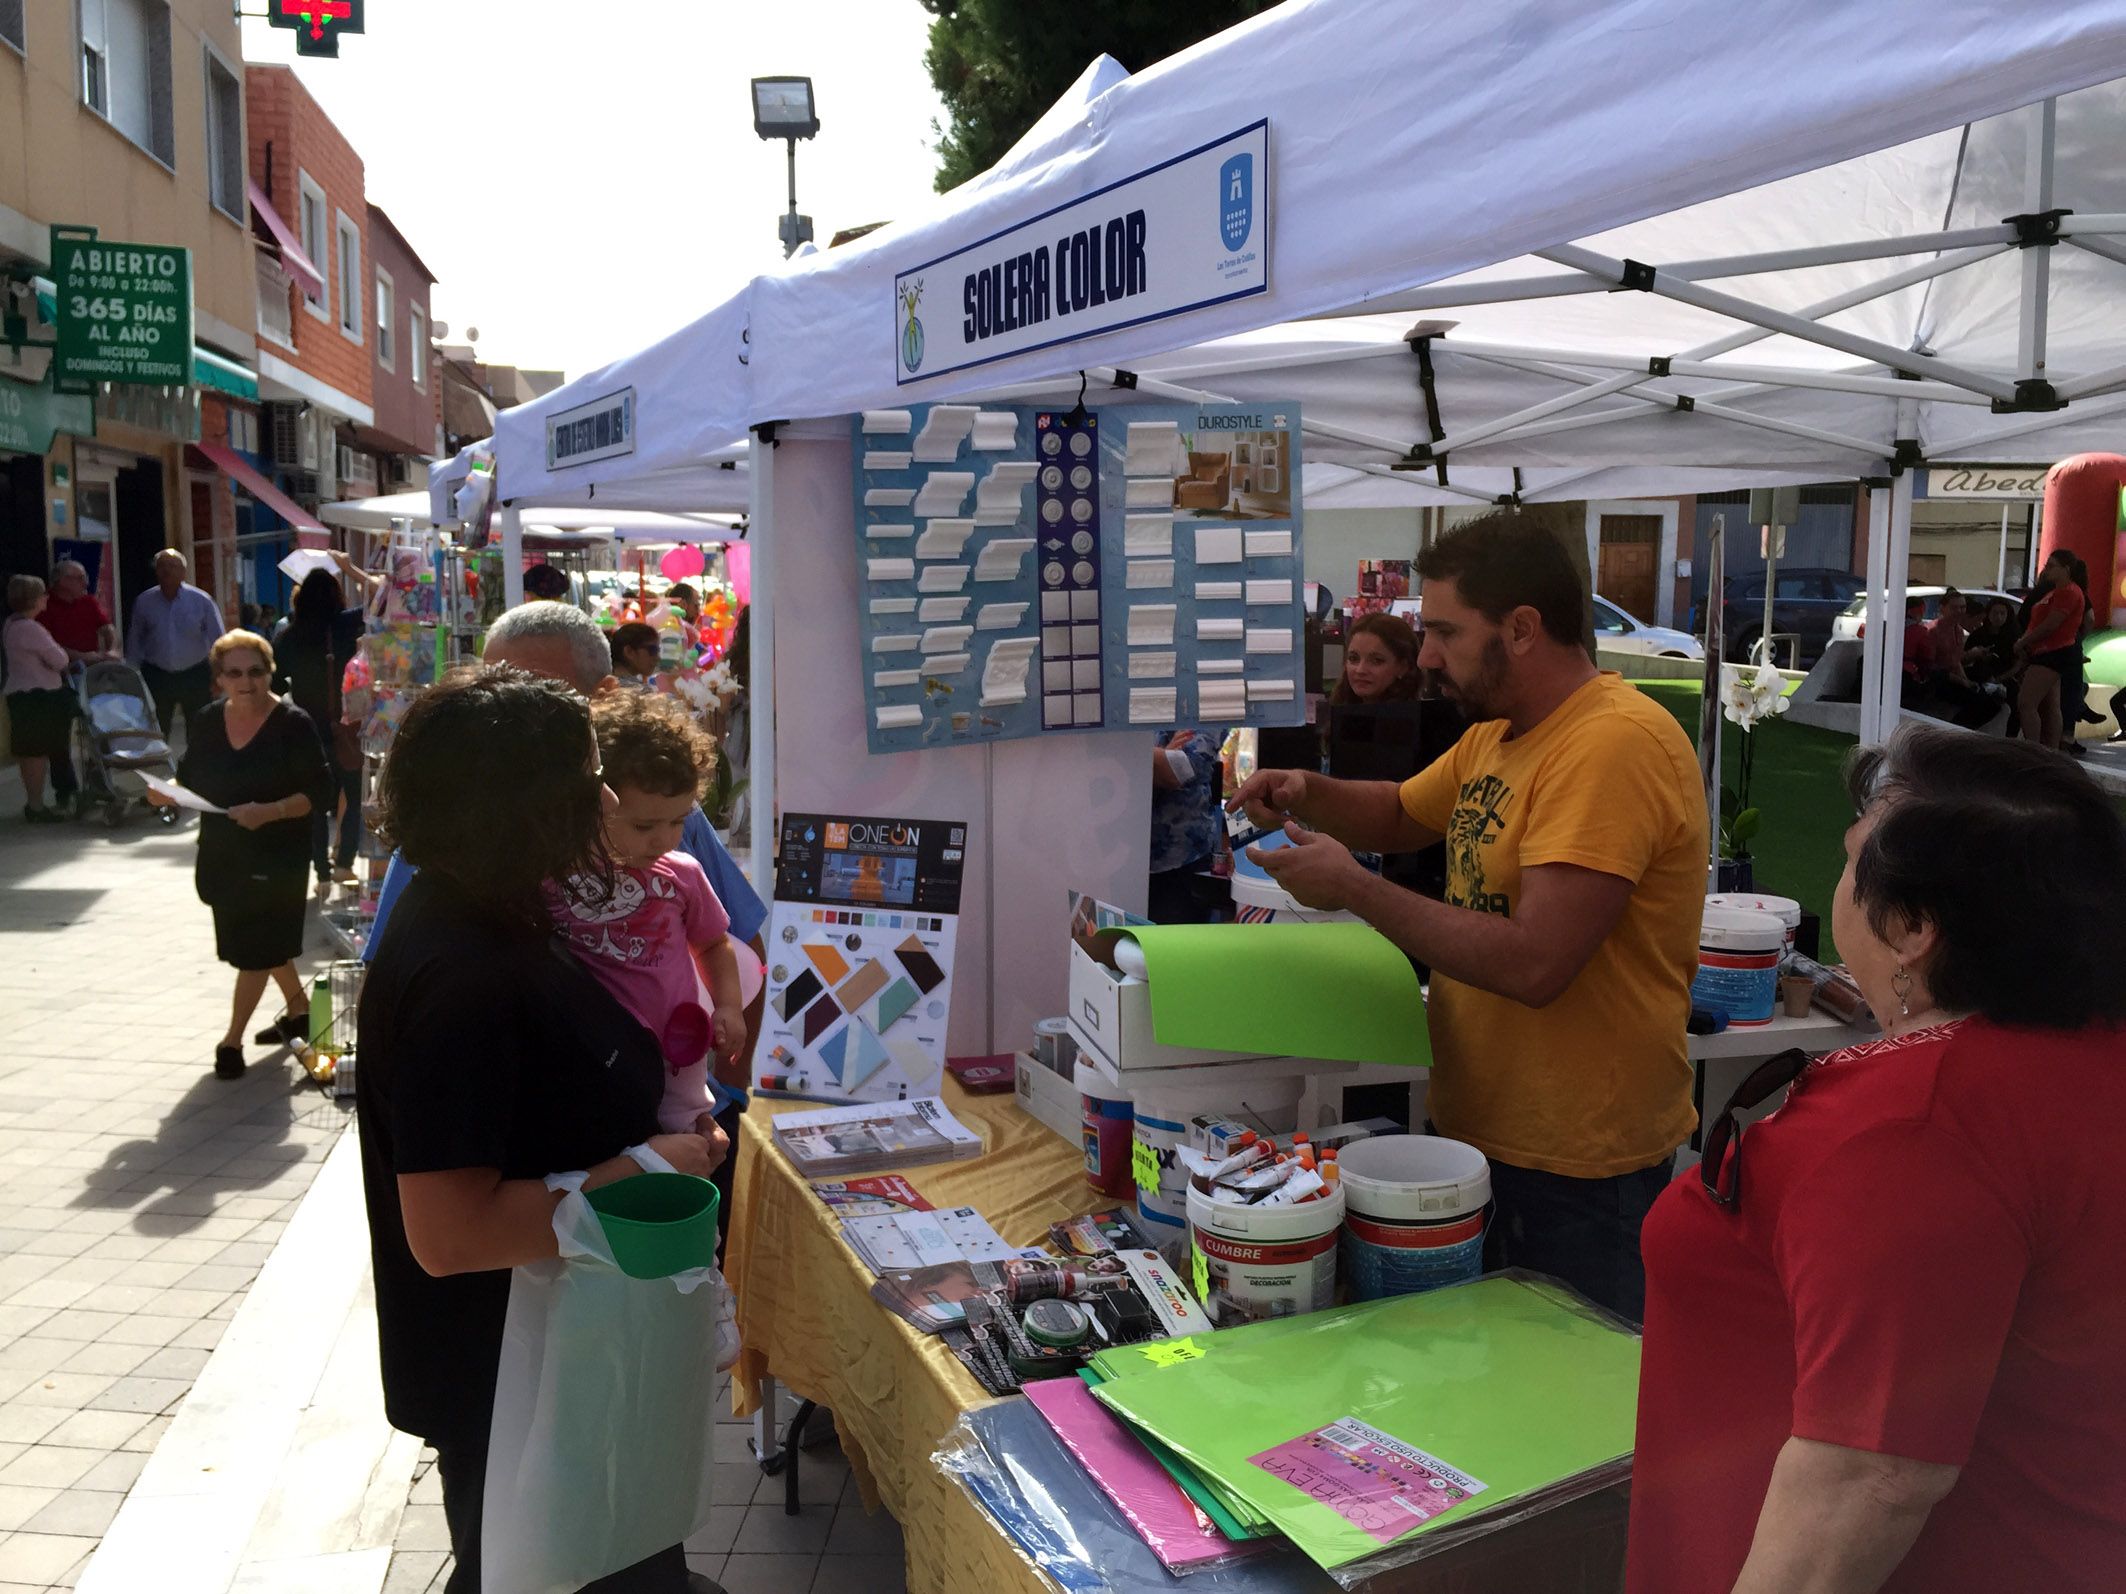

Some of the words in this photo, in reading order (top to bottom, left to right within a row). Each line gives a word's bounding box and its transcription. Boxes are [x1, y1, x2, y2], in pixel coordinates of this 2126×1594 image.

[70, 250, 176, 276] ABIERTO
[964, 245, 1050, 344] SOLERA
[1056, 208, 1146, 316] COLOR
[70, 296, 127, 322] 365
[133, 300, 177, 322] DÍAS
[88, 324, 110, 341] AL
[118, 322, 160, 344] AÑO
[98, 346, 150, 360] INCLUSO
[66, 358, 124, 374] DOMINGOS
[127, 360, 133, 374] Y
[136, 362, 182, 377] FESTIVOS
[1198, 414, 1263, 430] DUROSTYLE
[1942, 470, 2048, 492] Abed
[1206, 1238, 1262, 1260] CUMBRE
[1148, 1268, 1188, 1318] snazaroo
[1347, 1423, 1392, 1447] ESCOLAR
[1390, 1444, 1413, 1458] USO
[1261, 1458, 1314, 1487] EVA
[1412, 1455, 1470, 1488] PRODUCTO
[1310, 1484, 1386, 1530] GOMA
